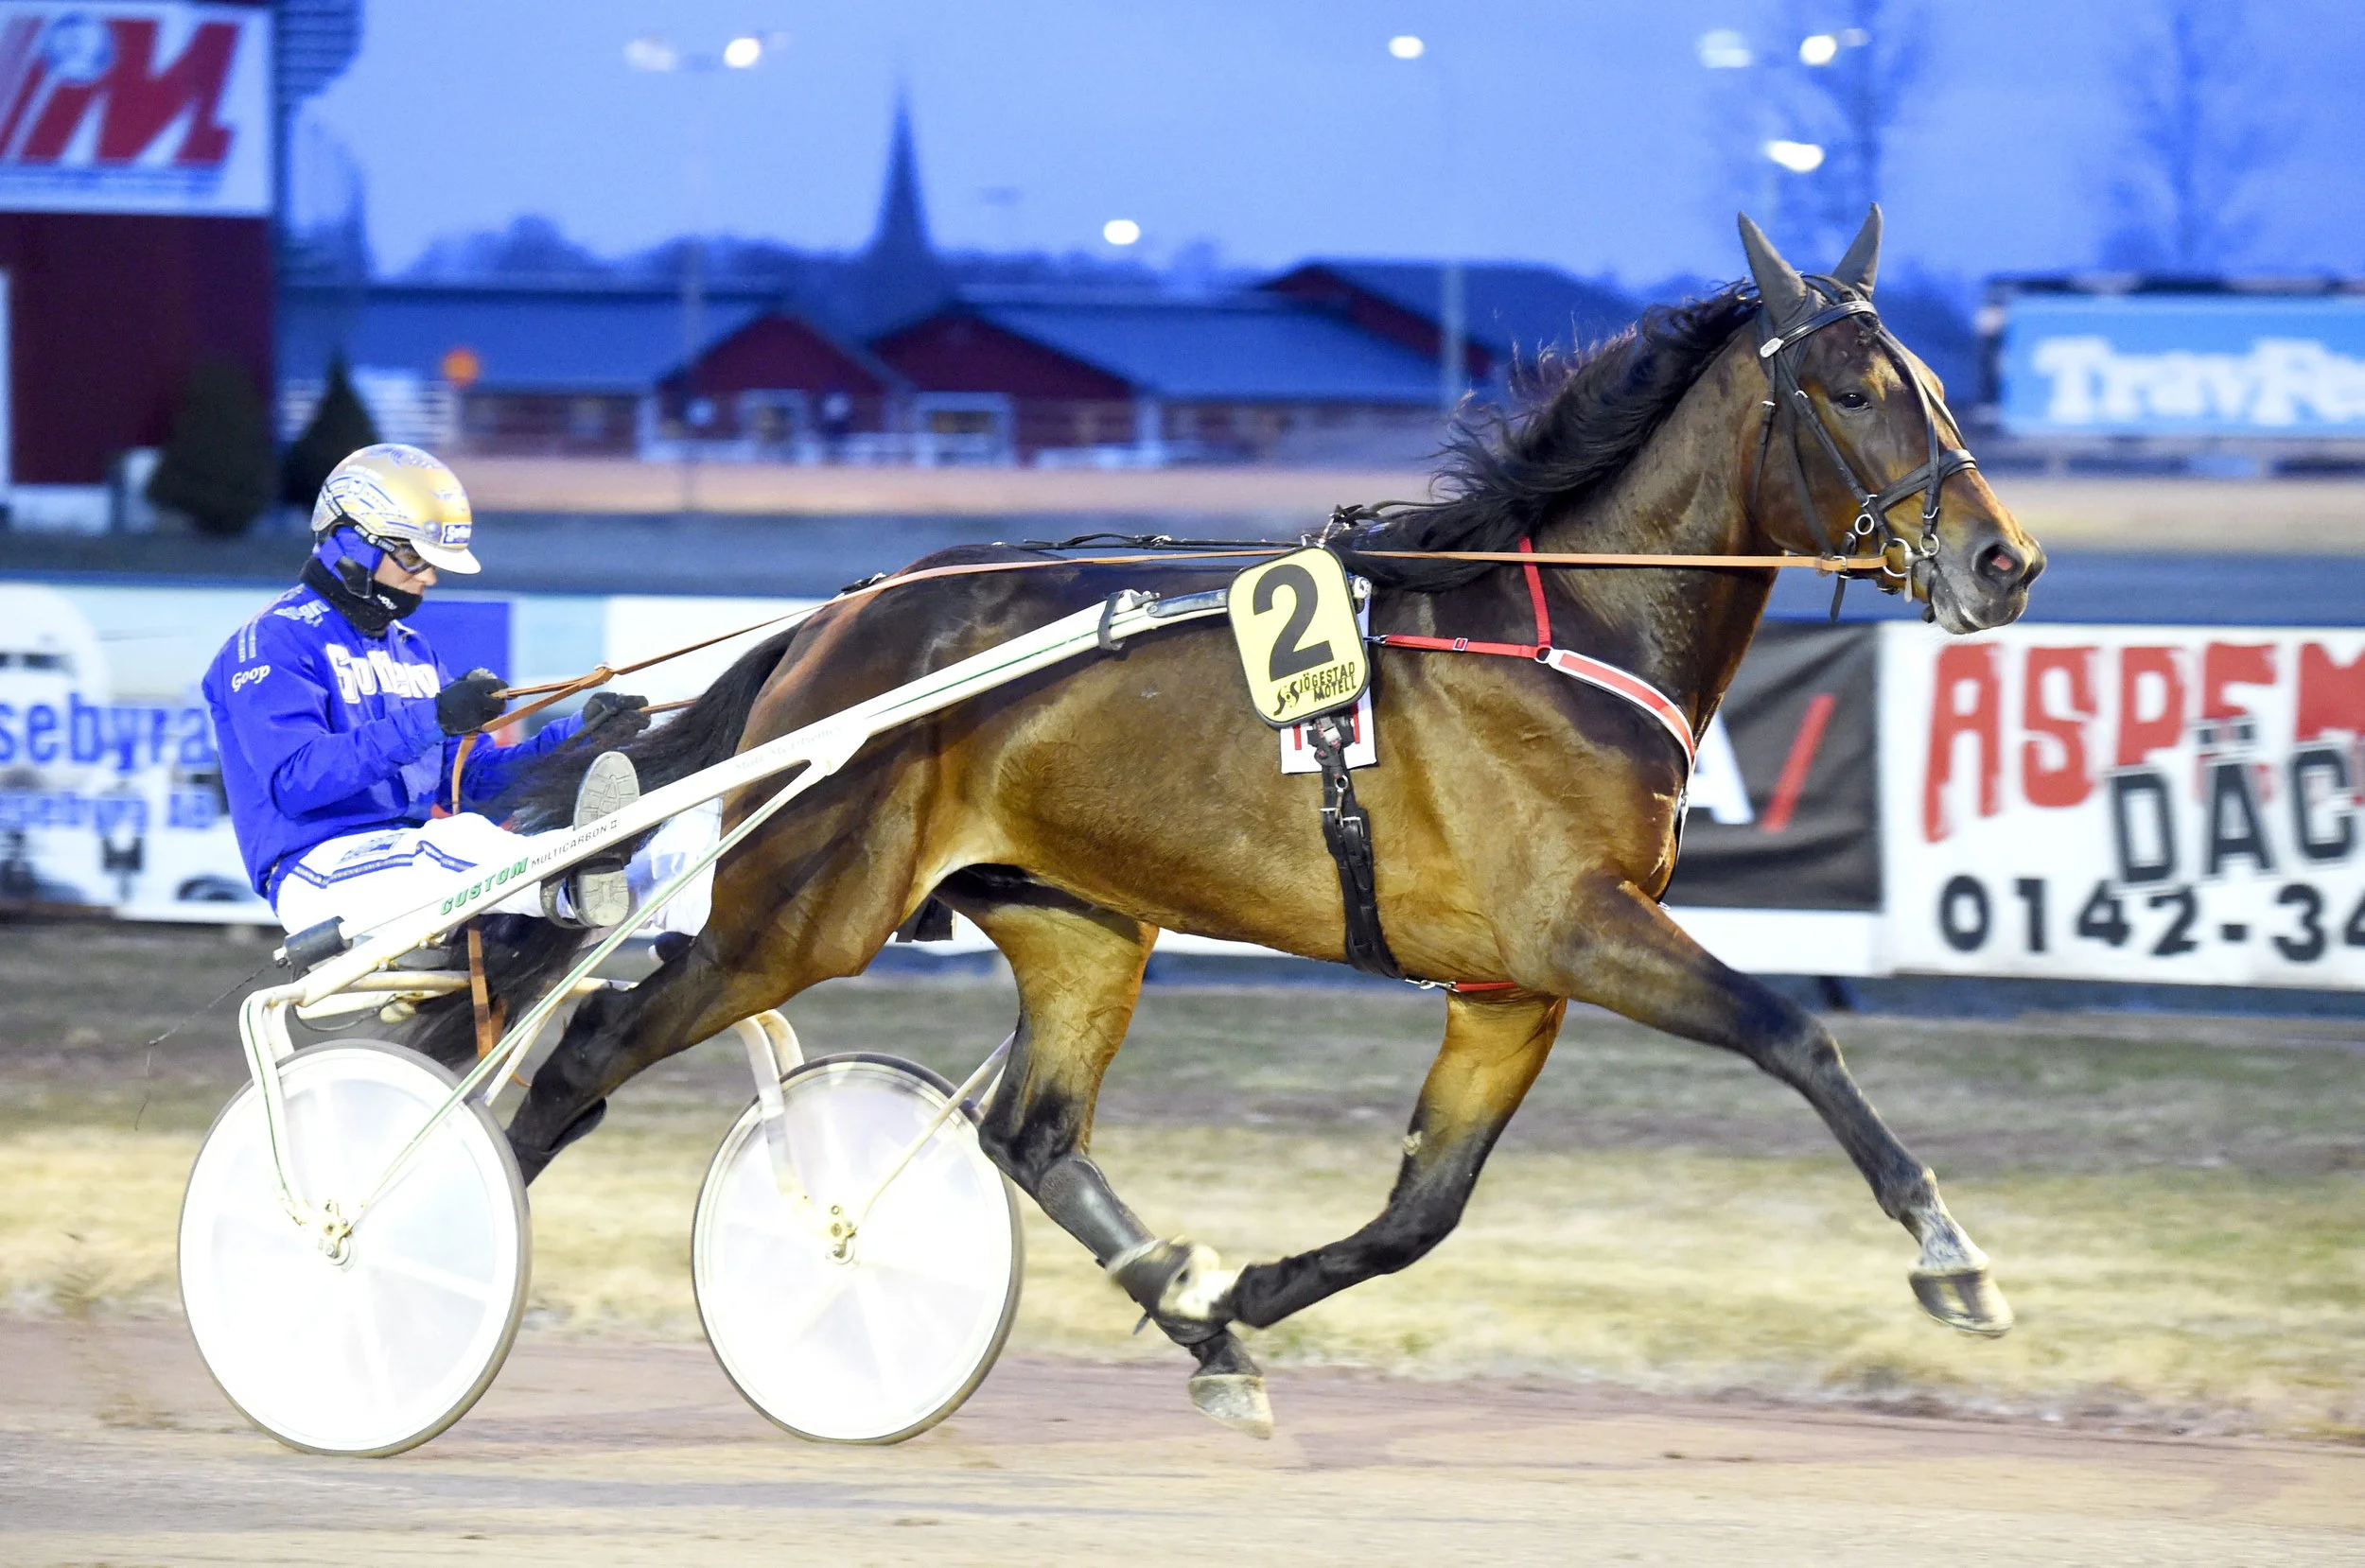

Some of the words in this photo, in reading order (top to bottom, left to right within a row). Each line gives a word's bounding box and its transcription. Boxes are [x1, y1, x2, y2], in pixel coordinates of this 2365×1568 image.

[1253, 564, 1334, 682] 2
[231, 665, 271, 692] Goop
[1313, 674, 1357, 702] MOTELL
[2110, 719, 2356, 885] DÄC
[440, 857, 529, 915] CUSTOM
[531, 825, 607, 868] MULTICARBON
